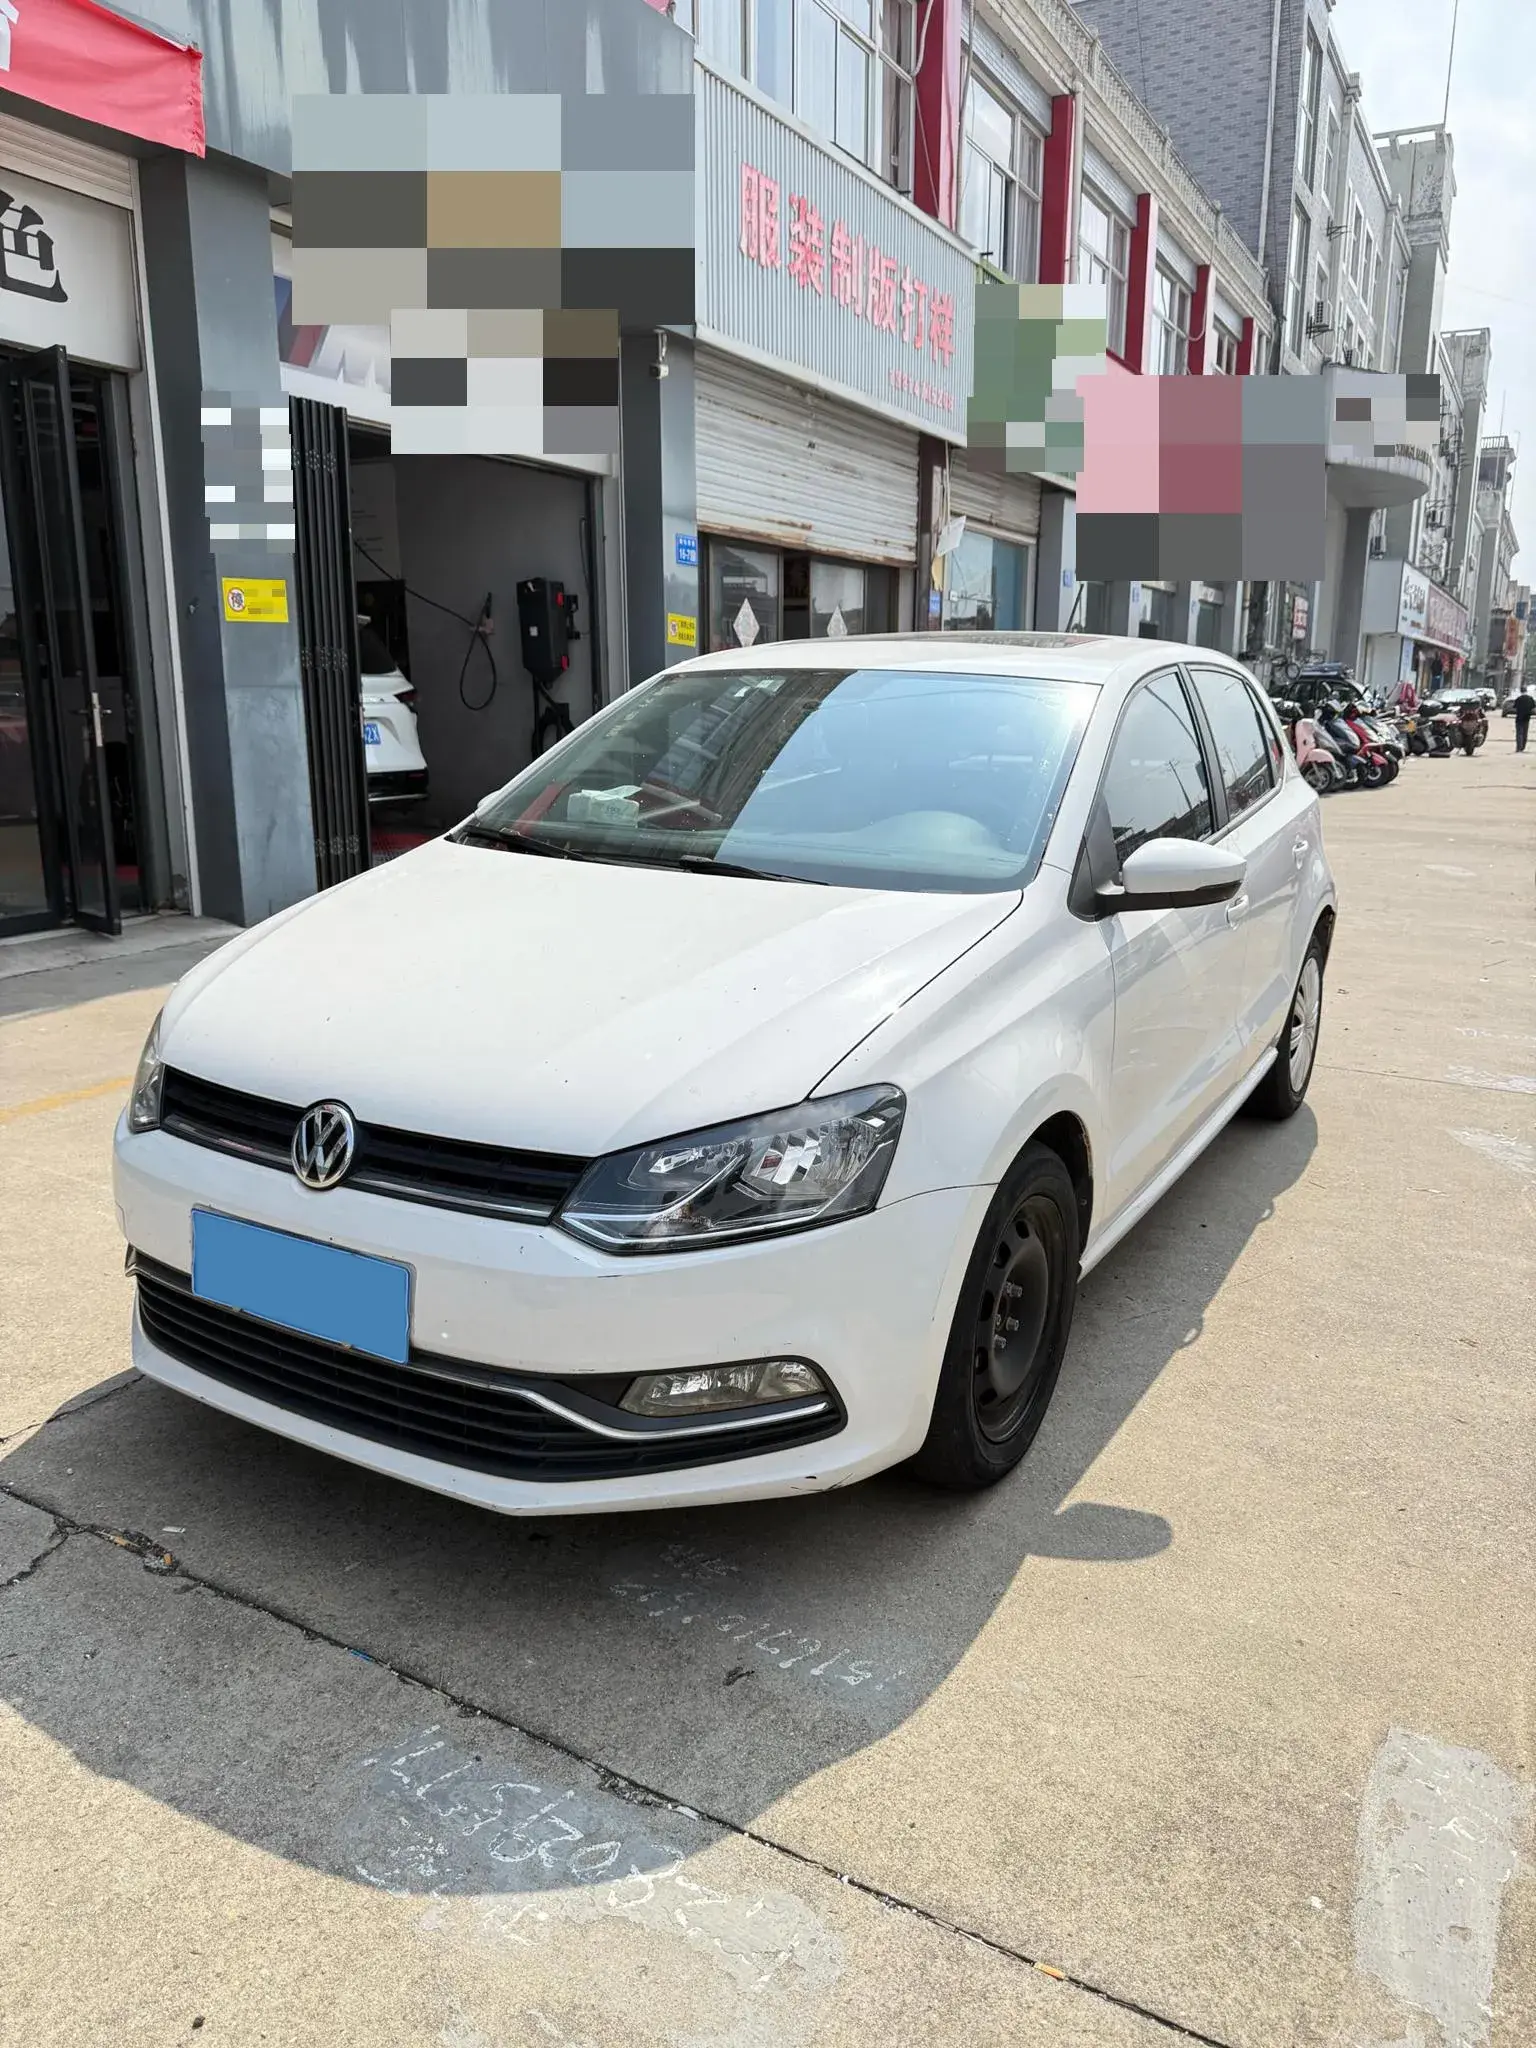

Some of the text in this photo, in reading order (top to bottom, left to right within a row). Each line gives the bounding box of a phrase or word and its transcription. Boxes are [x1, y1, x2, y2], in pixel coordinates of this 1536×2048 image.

[738, 162, 956, 368] 服装制版打样
